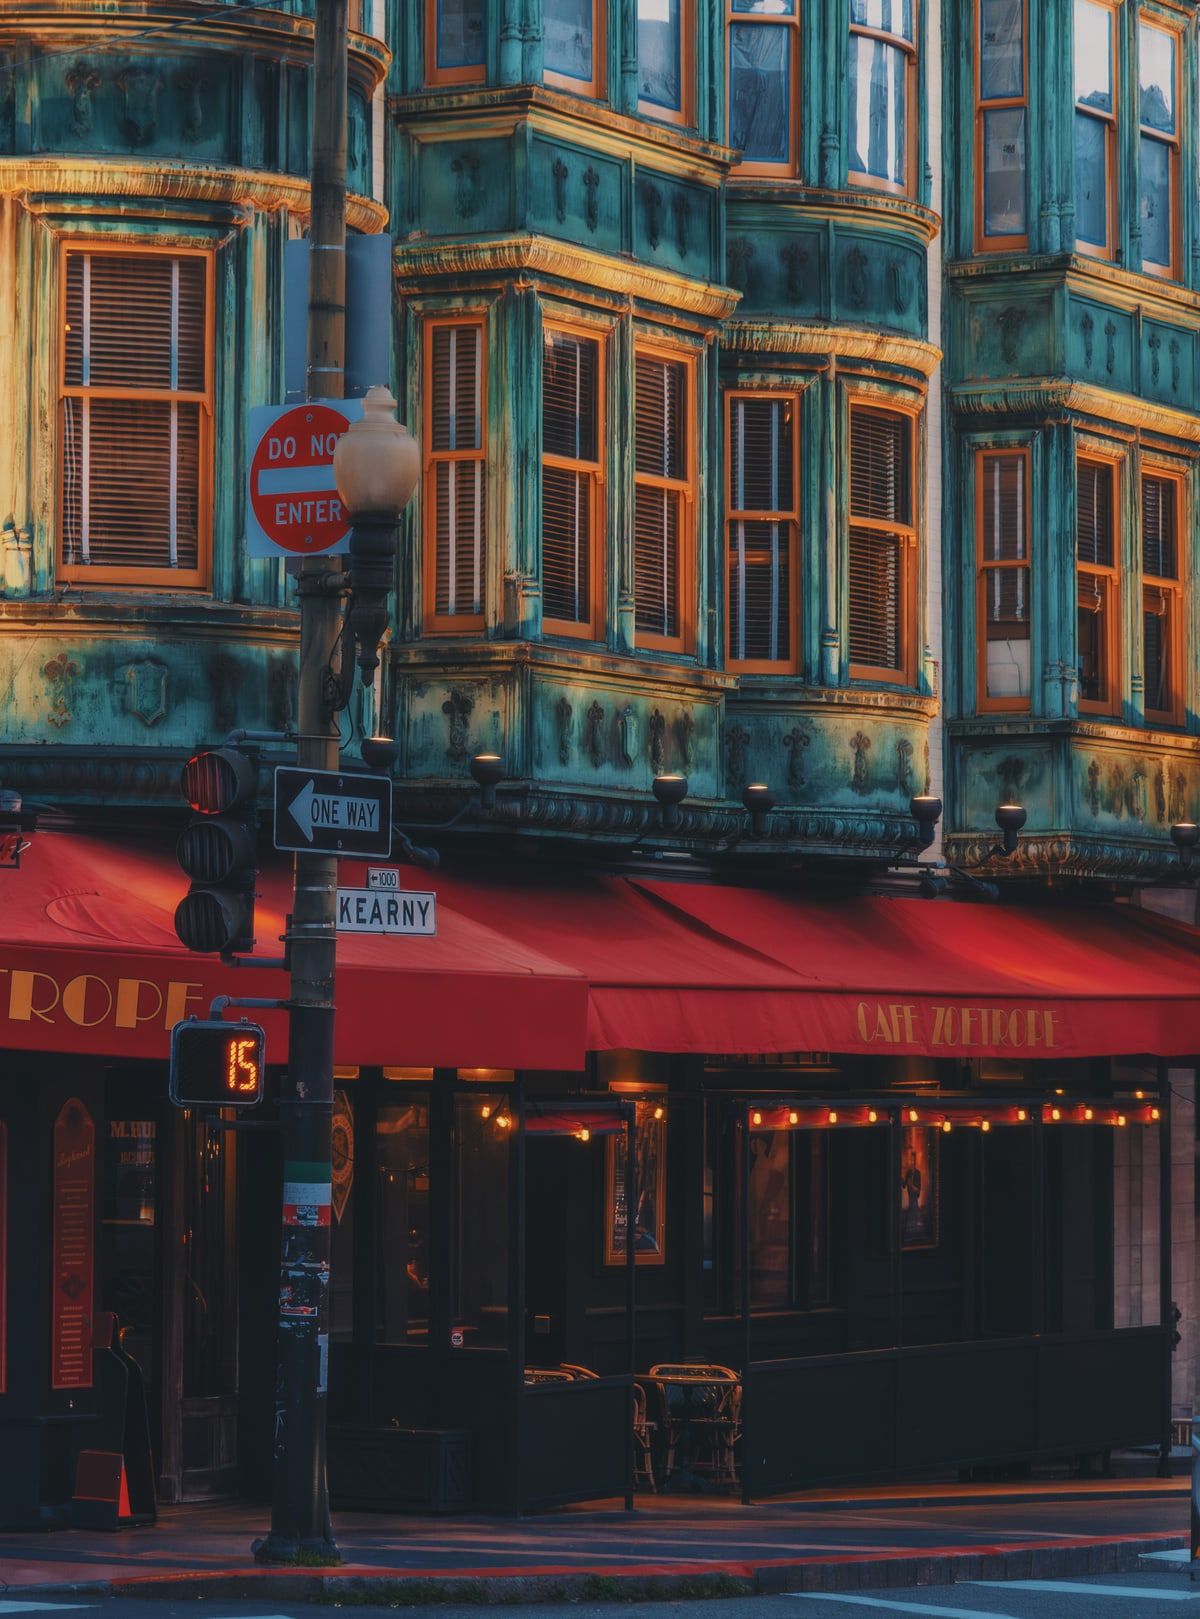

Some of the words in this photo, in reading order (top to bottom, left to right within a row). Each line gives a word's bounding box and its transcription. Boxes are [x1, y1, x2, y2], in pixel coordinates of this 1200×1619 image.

[269, 436, 296, 460] DO
[311, 433, 338, 457] NO
[275, 499, 342, 525] ENTER
[311, 798, 339, 825] ONE
[346, 801, 376, 828] WAY
[379, 872, 397, 886] 1000
[339, 896, 430, 927] KEARNY
[857, 1001, 919, 1044] CAFE
[931, 1006, 1062, 1047] ZOETROPE
[228, 1040, 257, 1091] 15
